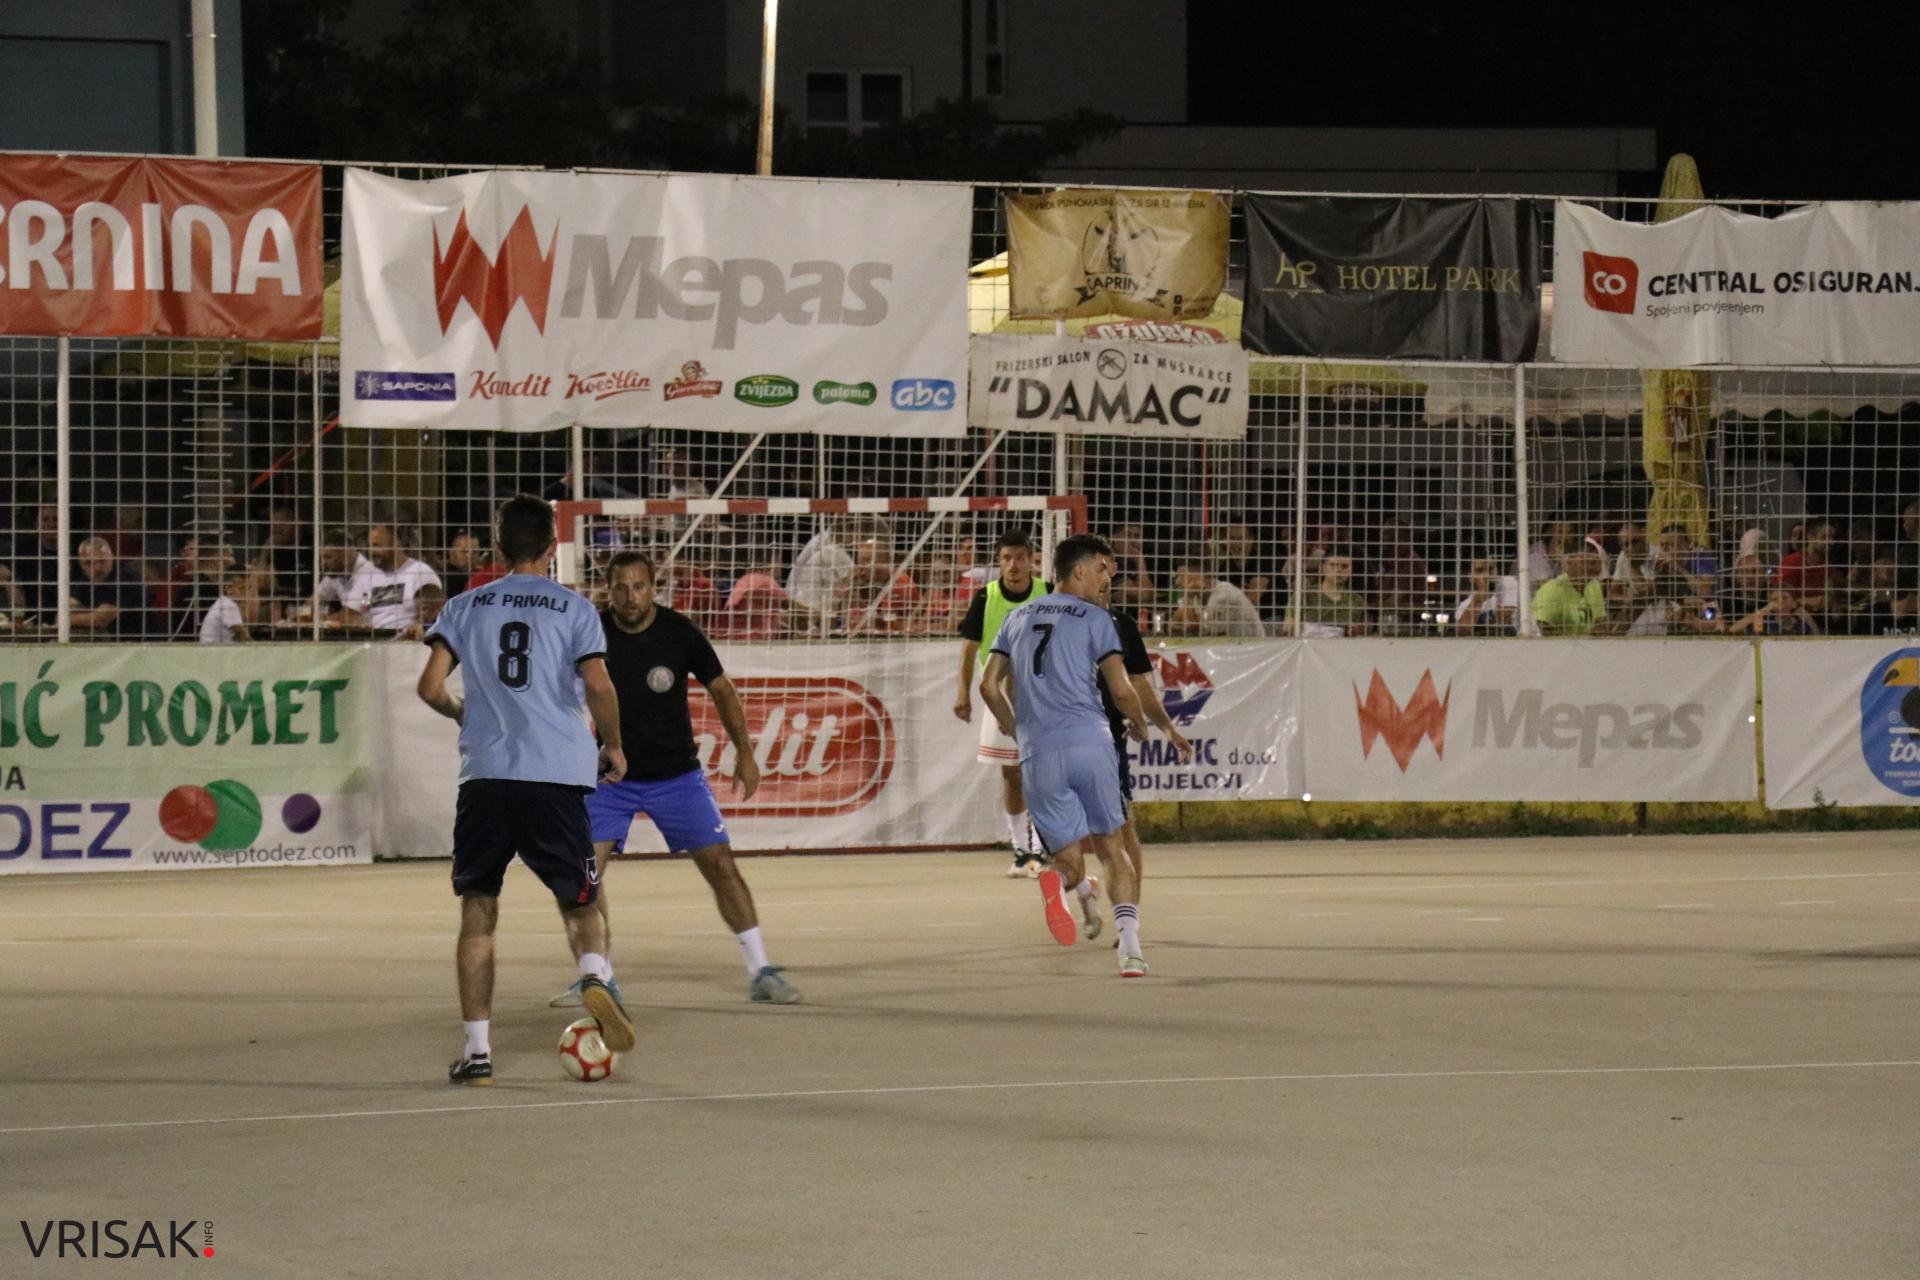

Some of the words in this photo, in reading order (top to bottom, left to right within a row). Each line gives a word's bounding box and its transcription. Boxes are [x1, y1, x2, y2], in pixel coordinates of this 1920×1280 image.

[0, 200, 302, 296] RNINA
[559, 234, 893, 350] Mepas
[1338, 265, 1437, 290] HOTEL
[1445, 266, 1521, 294] PARK
[1648, 270, 1765, 298] CENTRAL
[1773, 270, 1920, 294] OSIGURAN
[1056, 351, 1091, 367] SALON
[1133, 352, 1149, 365] ZA
[382, 381, 452, 392] SAPONIA
[469, 370, 552, 400] Kandit
[739, 382, 795, 398] ZVIJEZDA
[820, 385, 871, 400] paloma
[894, 380, 949, 407] abc
[472, 592, 497, 608] MZ
[502, 594, 569, 613] PRIVALJ
[1036, 604, 1087, 618] PRIVALJ
[498, 621, 533, 692] 8
[1032, 623, 1055, 679] 7
[82, 678, 349, 748] PROMET
[1471, 688, 1704, 769] Mepas
[1889, 737, 1920, 762] to
[153, 843, 356, 867] www.septodez.com
